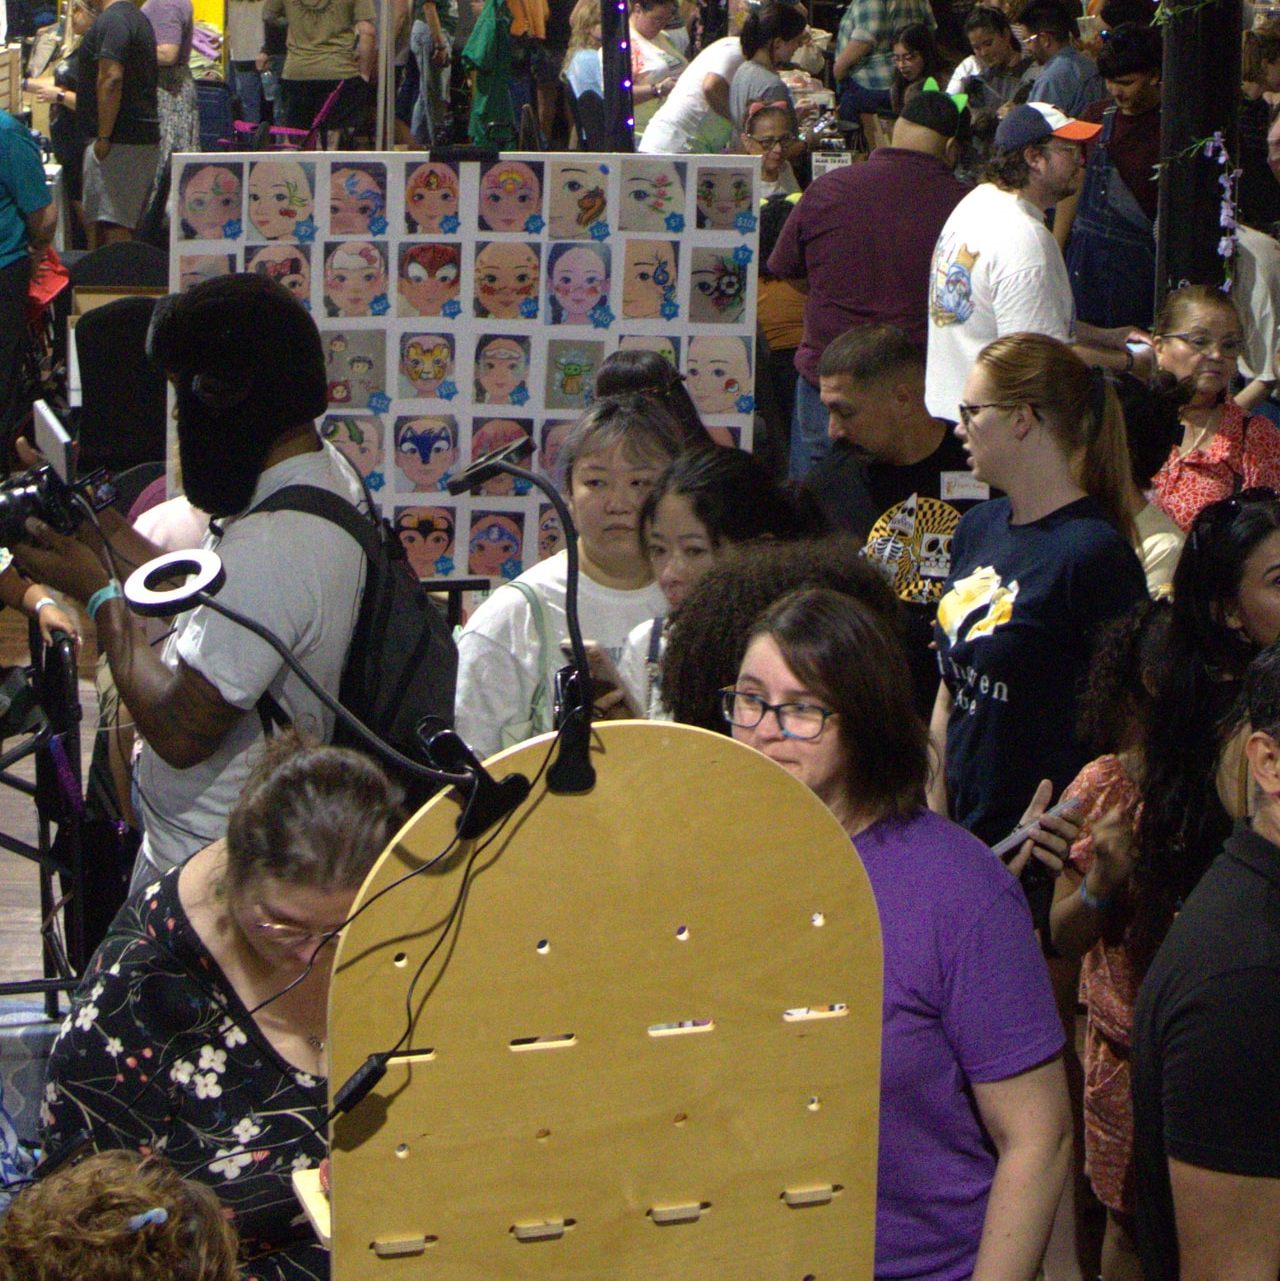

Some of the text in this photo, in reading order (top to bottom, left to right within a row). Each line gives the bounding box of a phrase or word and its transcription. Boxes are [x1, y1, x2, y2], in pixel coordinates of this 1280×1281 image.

[737, 216, 755, 228] $10
[299, 224, 312, 235] $7
[595, 310, 611, 324] $10
